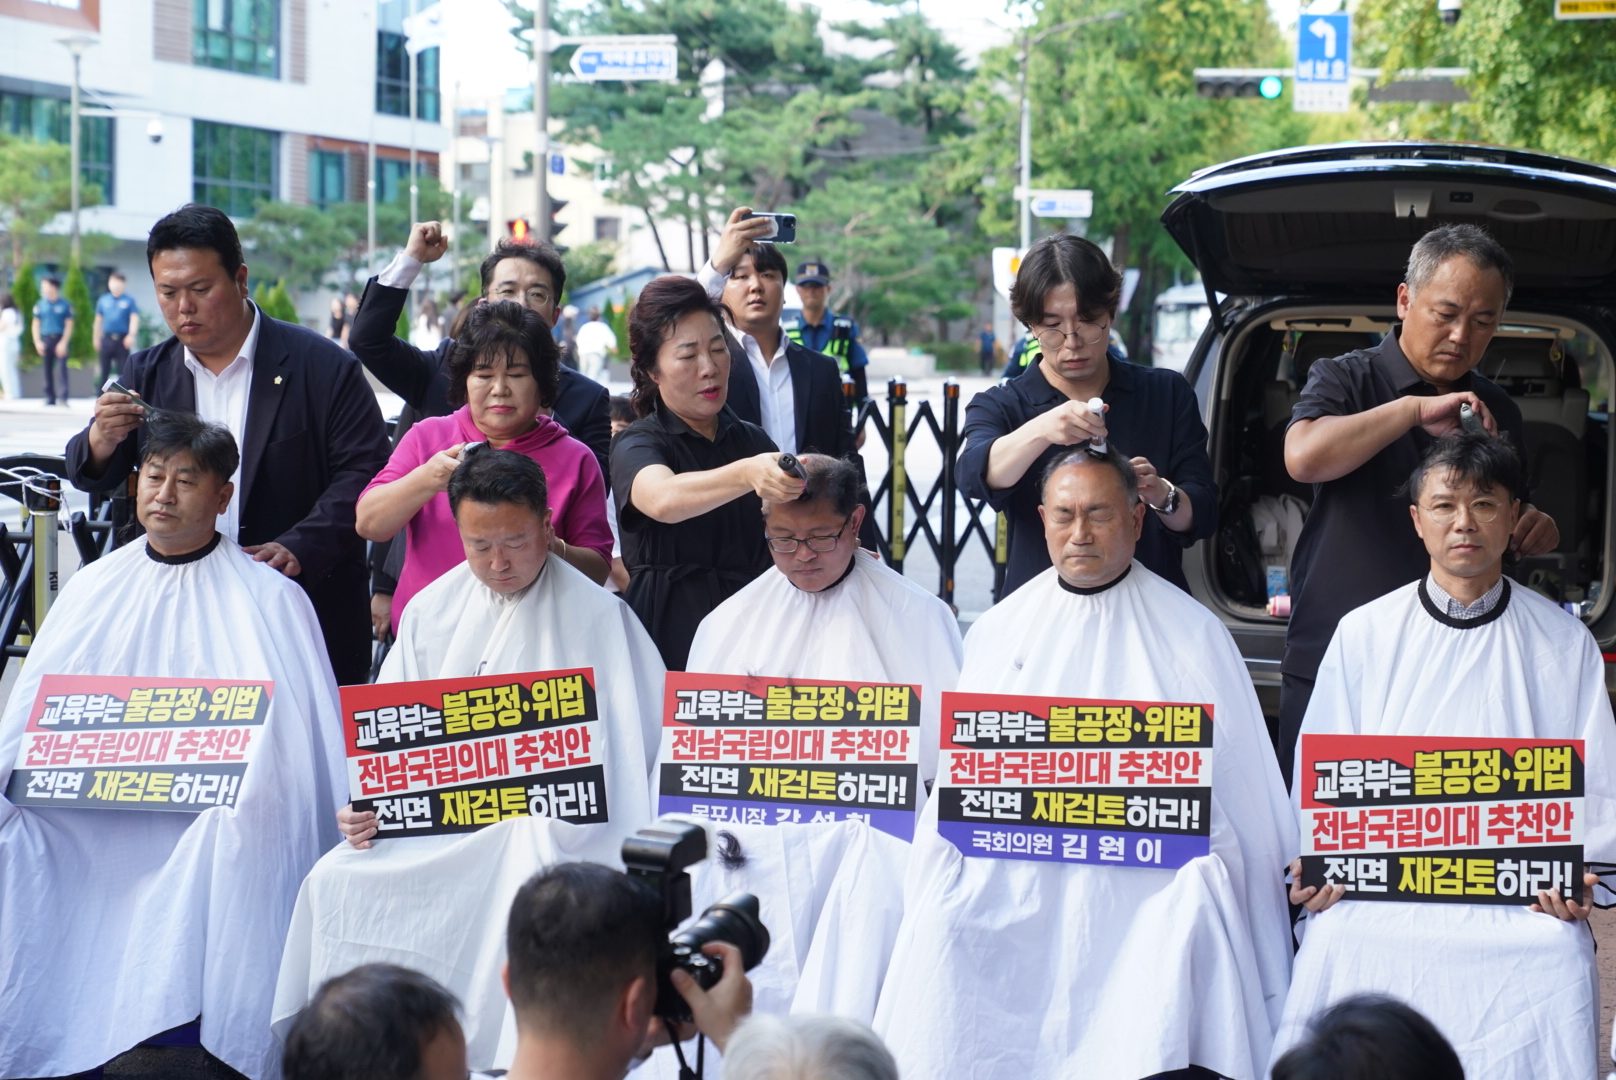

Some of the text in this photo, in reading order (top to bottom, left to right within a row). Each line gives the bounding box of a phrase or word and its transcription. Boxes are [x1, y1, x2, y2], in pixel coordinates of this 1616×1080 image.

[38, 685, 263, 726] 교육부는 불공정·위법
[353, 674, 586, 748] 교육부는 불공정·위법
[674, 685, 910, 722] 교육부는 불공정·위법
[952, 705, 1202, 744] 교육부는 불공정·위법
[25, 728, 252, 766] 전남국립의대 추천안
[357, 725, 591, 796] 전남국립의대 추천안
[671, 729, 910, 761] 전남국립의대 추천안
[26, 770, 240, 805] 전면 재검토하라!
[680, 765, 907, 805] 전면 재검토하라!
[950, 751, 1202, 785] 전남국립의대 추천안
[1313, 746, 1573, 800] 교육부는 불공정·위법
[372, 781, 599, 831] 전면 재검토하라!
[960, 789, 1200, 830] 전면 재검토하라!
[972, 830, 1053, 856] 국회의원
[1312, 801, 1574, 852] 전남국립의대 추천안
[1323, 856, 1573, 898] 전면 재검토하라!
